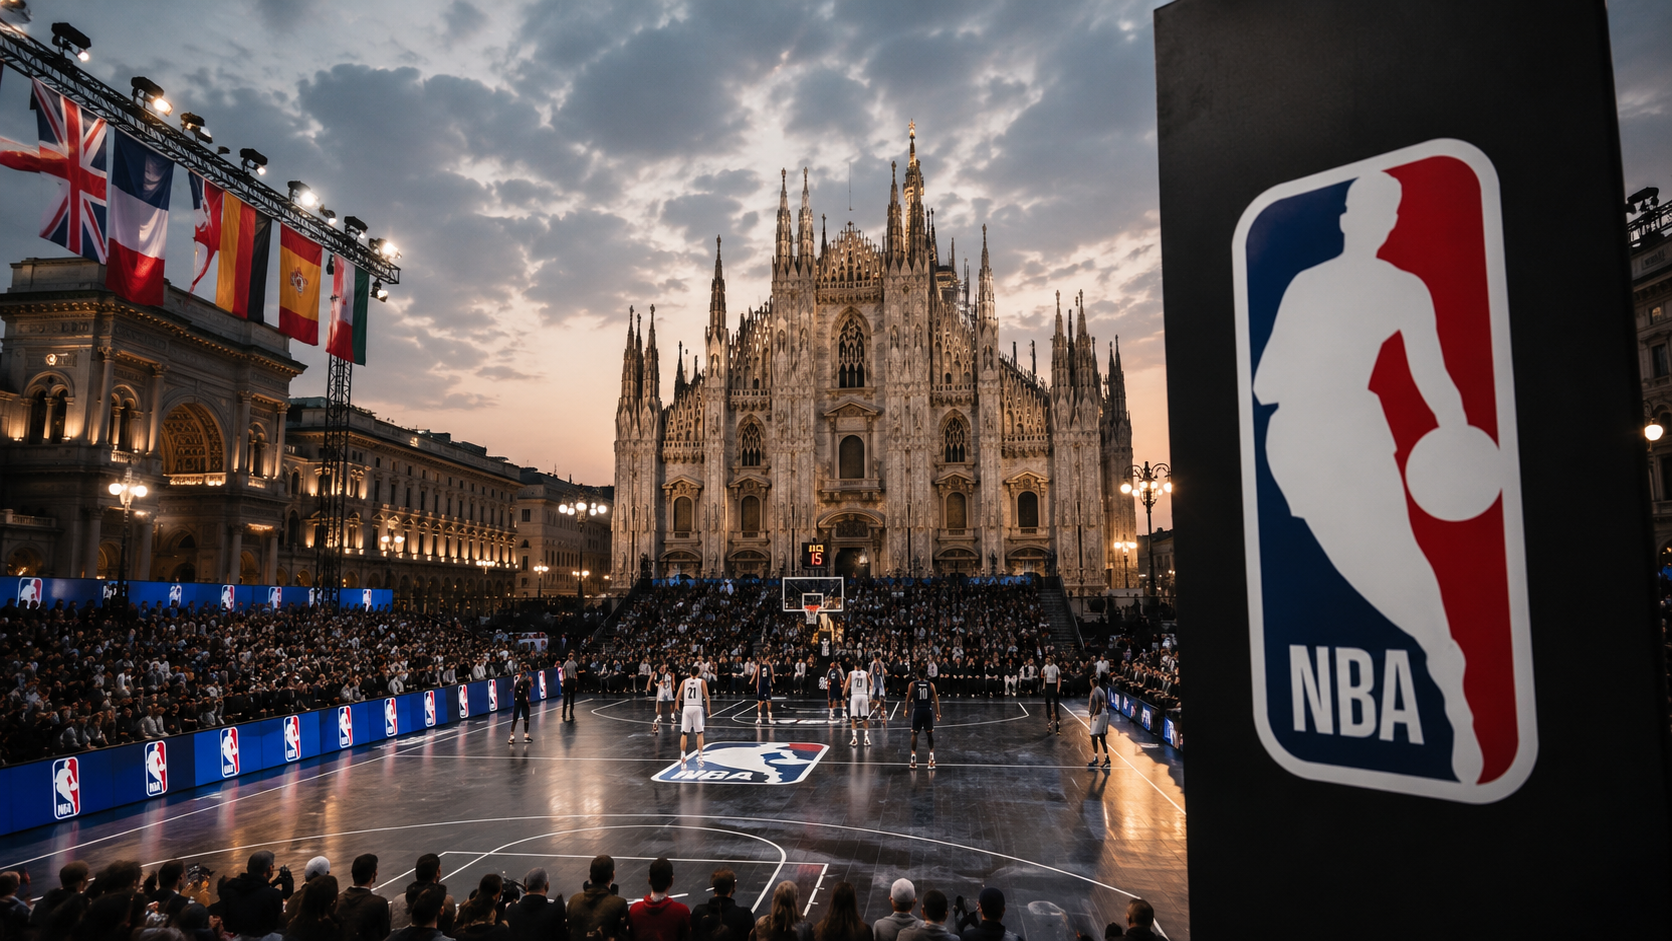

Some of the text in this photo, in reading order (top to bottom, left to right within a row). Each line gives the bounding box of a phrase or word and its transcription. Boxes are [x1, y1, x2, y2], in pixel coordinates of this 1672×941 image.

[811, 552, 822, 566] 15
[687, 686, 697, 699] 21
[918, 687, 928, 700] 10
[1289, 644, 1425, 745] NBA
[670, 769, 754, 781] NBA
